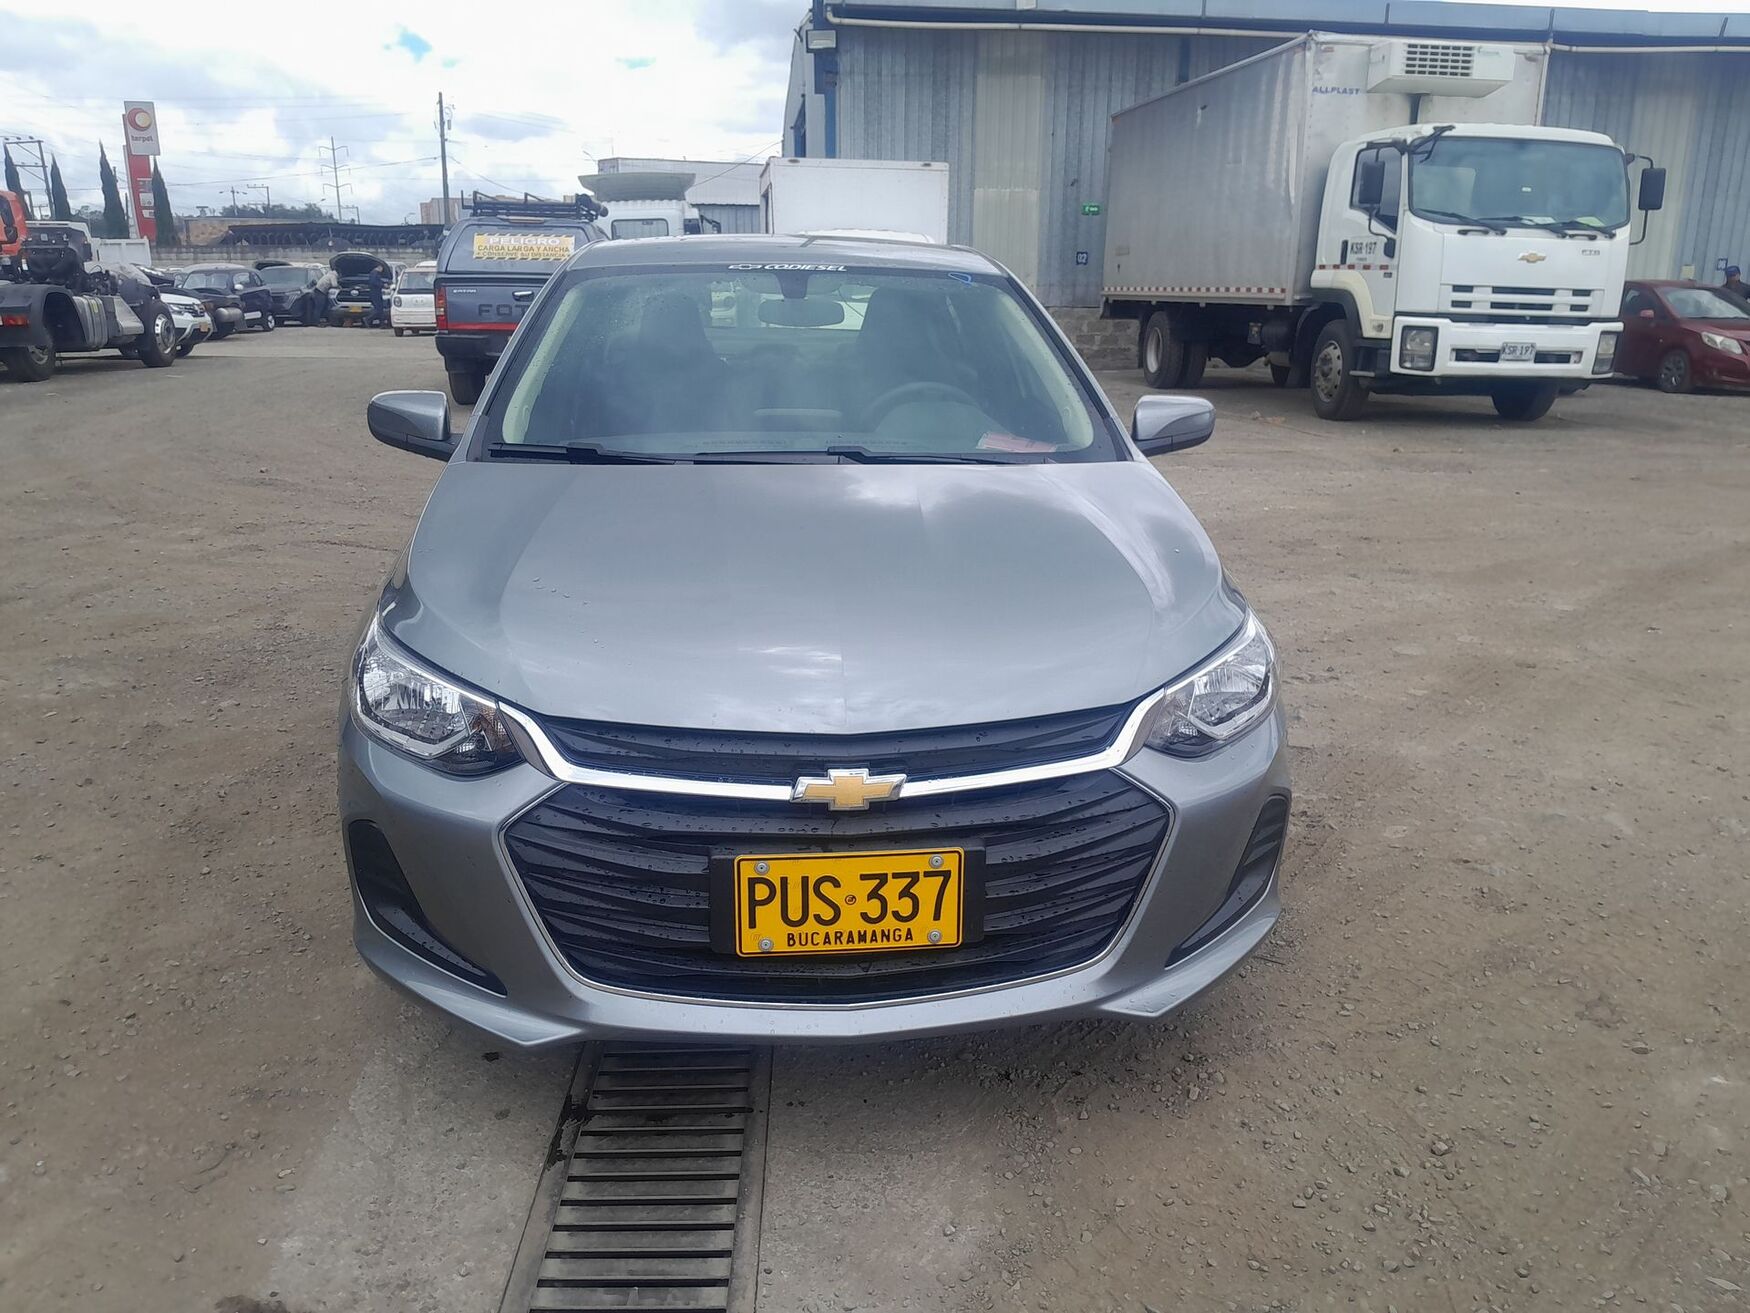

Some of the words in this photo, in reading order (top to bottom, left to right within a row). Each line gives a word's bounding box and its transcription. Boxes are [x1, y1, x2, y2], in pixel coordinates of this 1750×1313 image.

[1312, 86, 1360, 95] ALLPLAST
[489, 237, 560, 245] PELIGRO
[764, 263, 847, 272] CODIESEL
[787, 927, 913, 947] BUCARAMANGA
